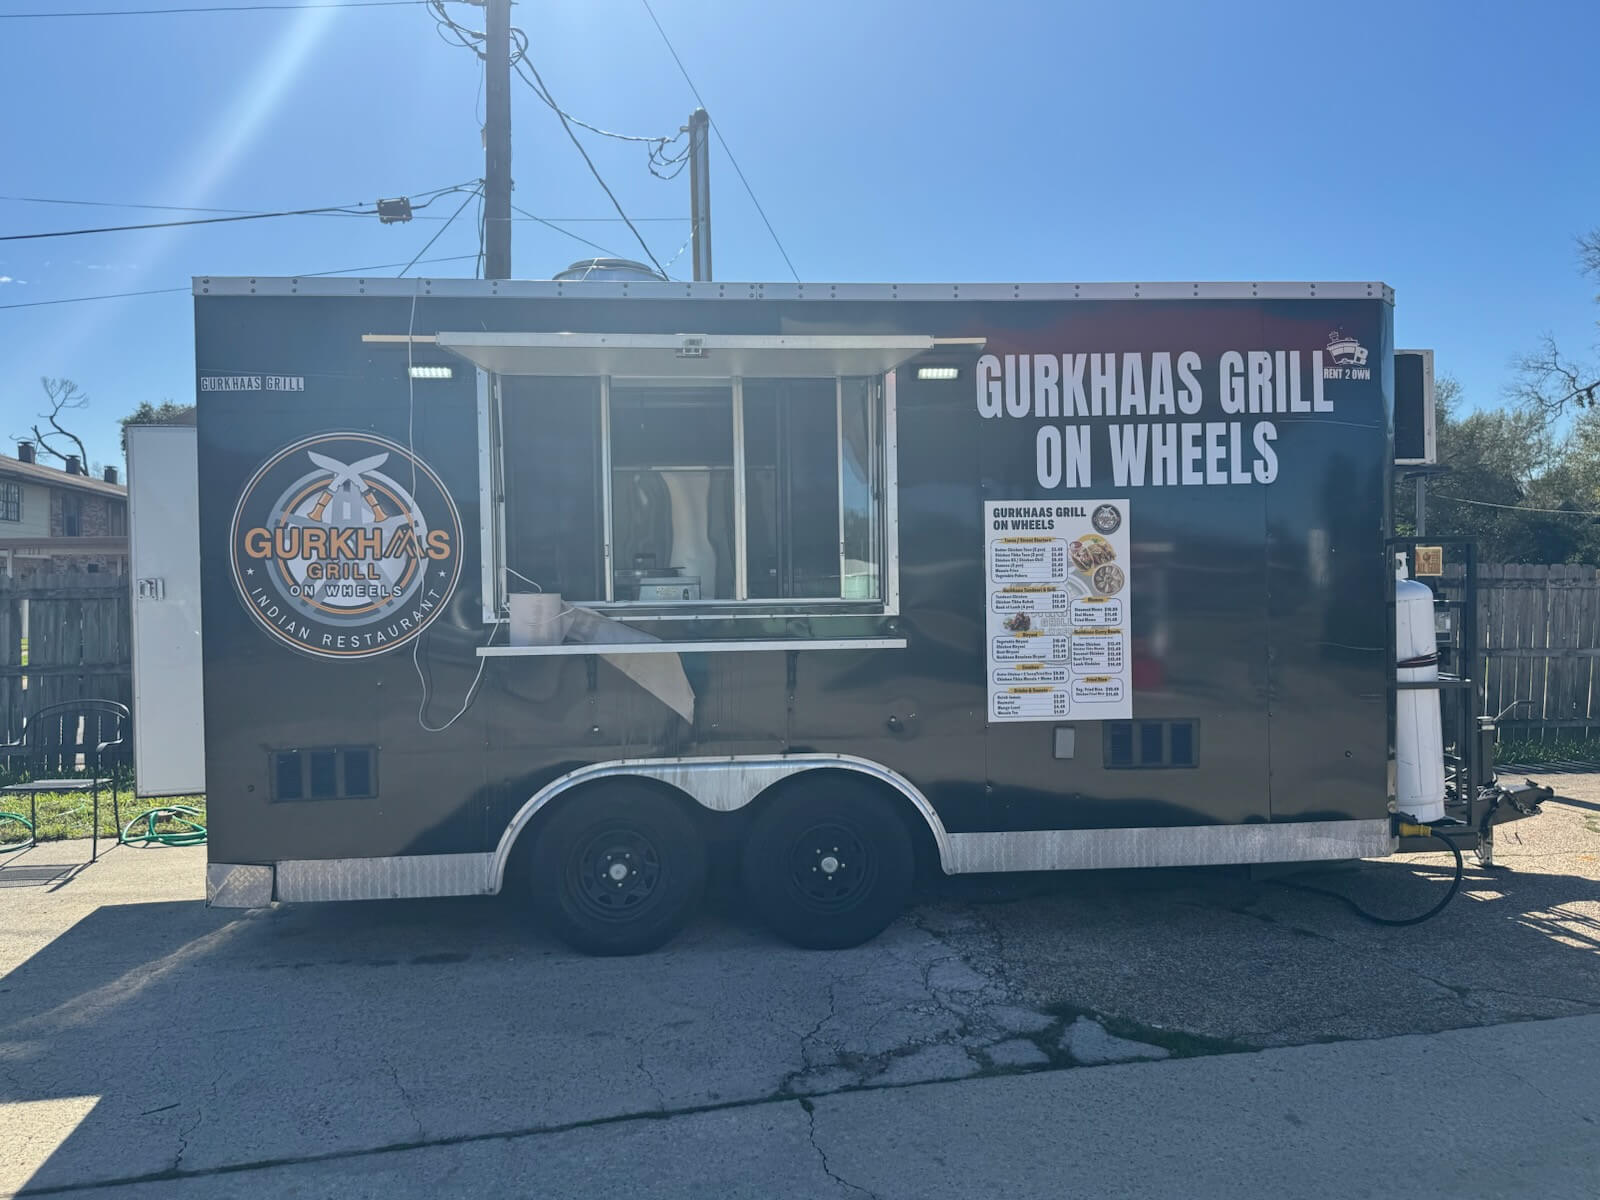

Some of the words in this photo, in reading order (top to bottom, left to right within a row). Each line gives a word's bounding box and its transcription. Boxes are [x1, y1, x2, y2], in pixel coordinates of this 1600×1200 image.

[1323, 368, 1343, 380] RENT
[1345, 369, 1351, 380] 2
[1352, 368, 1371, 380] OWN
[201, 376, 261, 391] GURKHAAS
[265, 376, 304, 391] GRILL
[976, 350, 1203, 419] GURKHAAS
[1219, 350, 1334, 414] GRILL
[1036, 424, 1092, 489] ON
[1108, 421, 1279, 488] WHEELS
[993, 507, 1053, 518] GURKHAAS
[1055, 506, 1087, 518] GRILL
[993, 520, 1009, 531] ON
[1011, 519, 1055, 531] WHEELS
[306, 562, 381, 580] GRILL
[290, 584, 315, 598] ON
[326, 584, 403, 598] WHEELS
[251, 586, 311, 641] INDIAN
[322, 588, 441, 648] RESTAURANT
